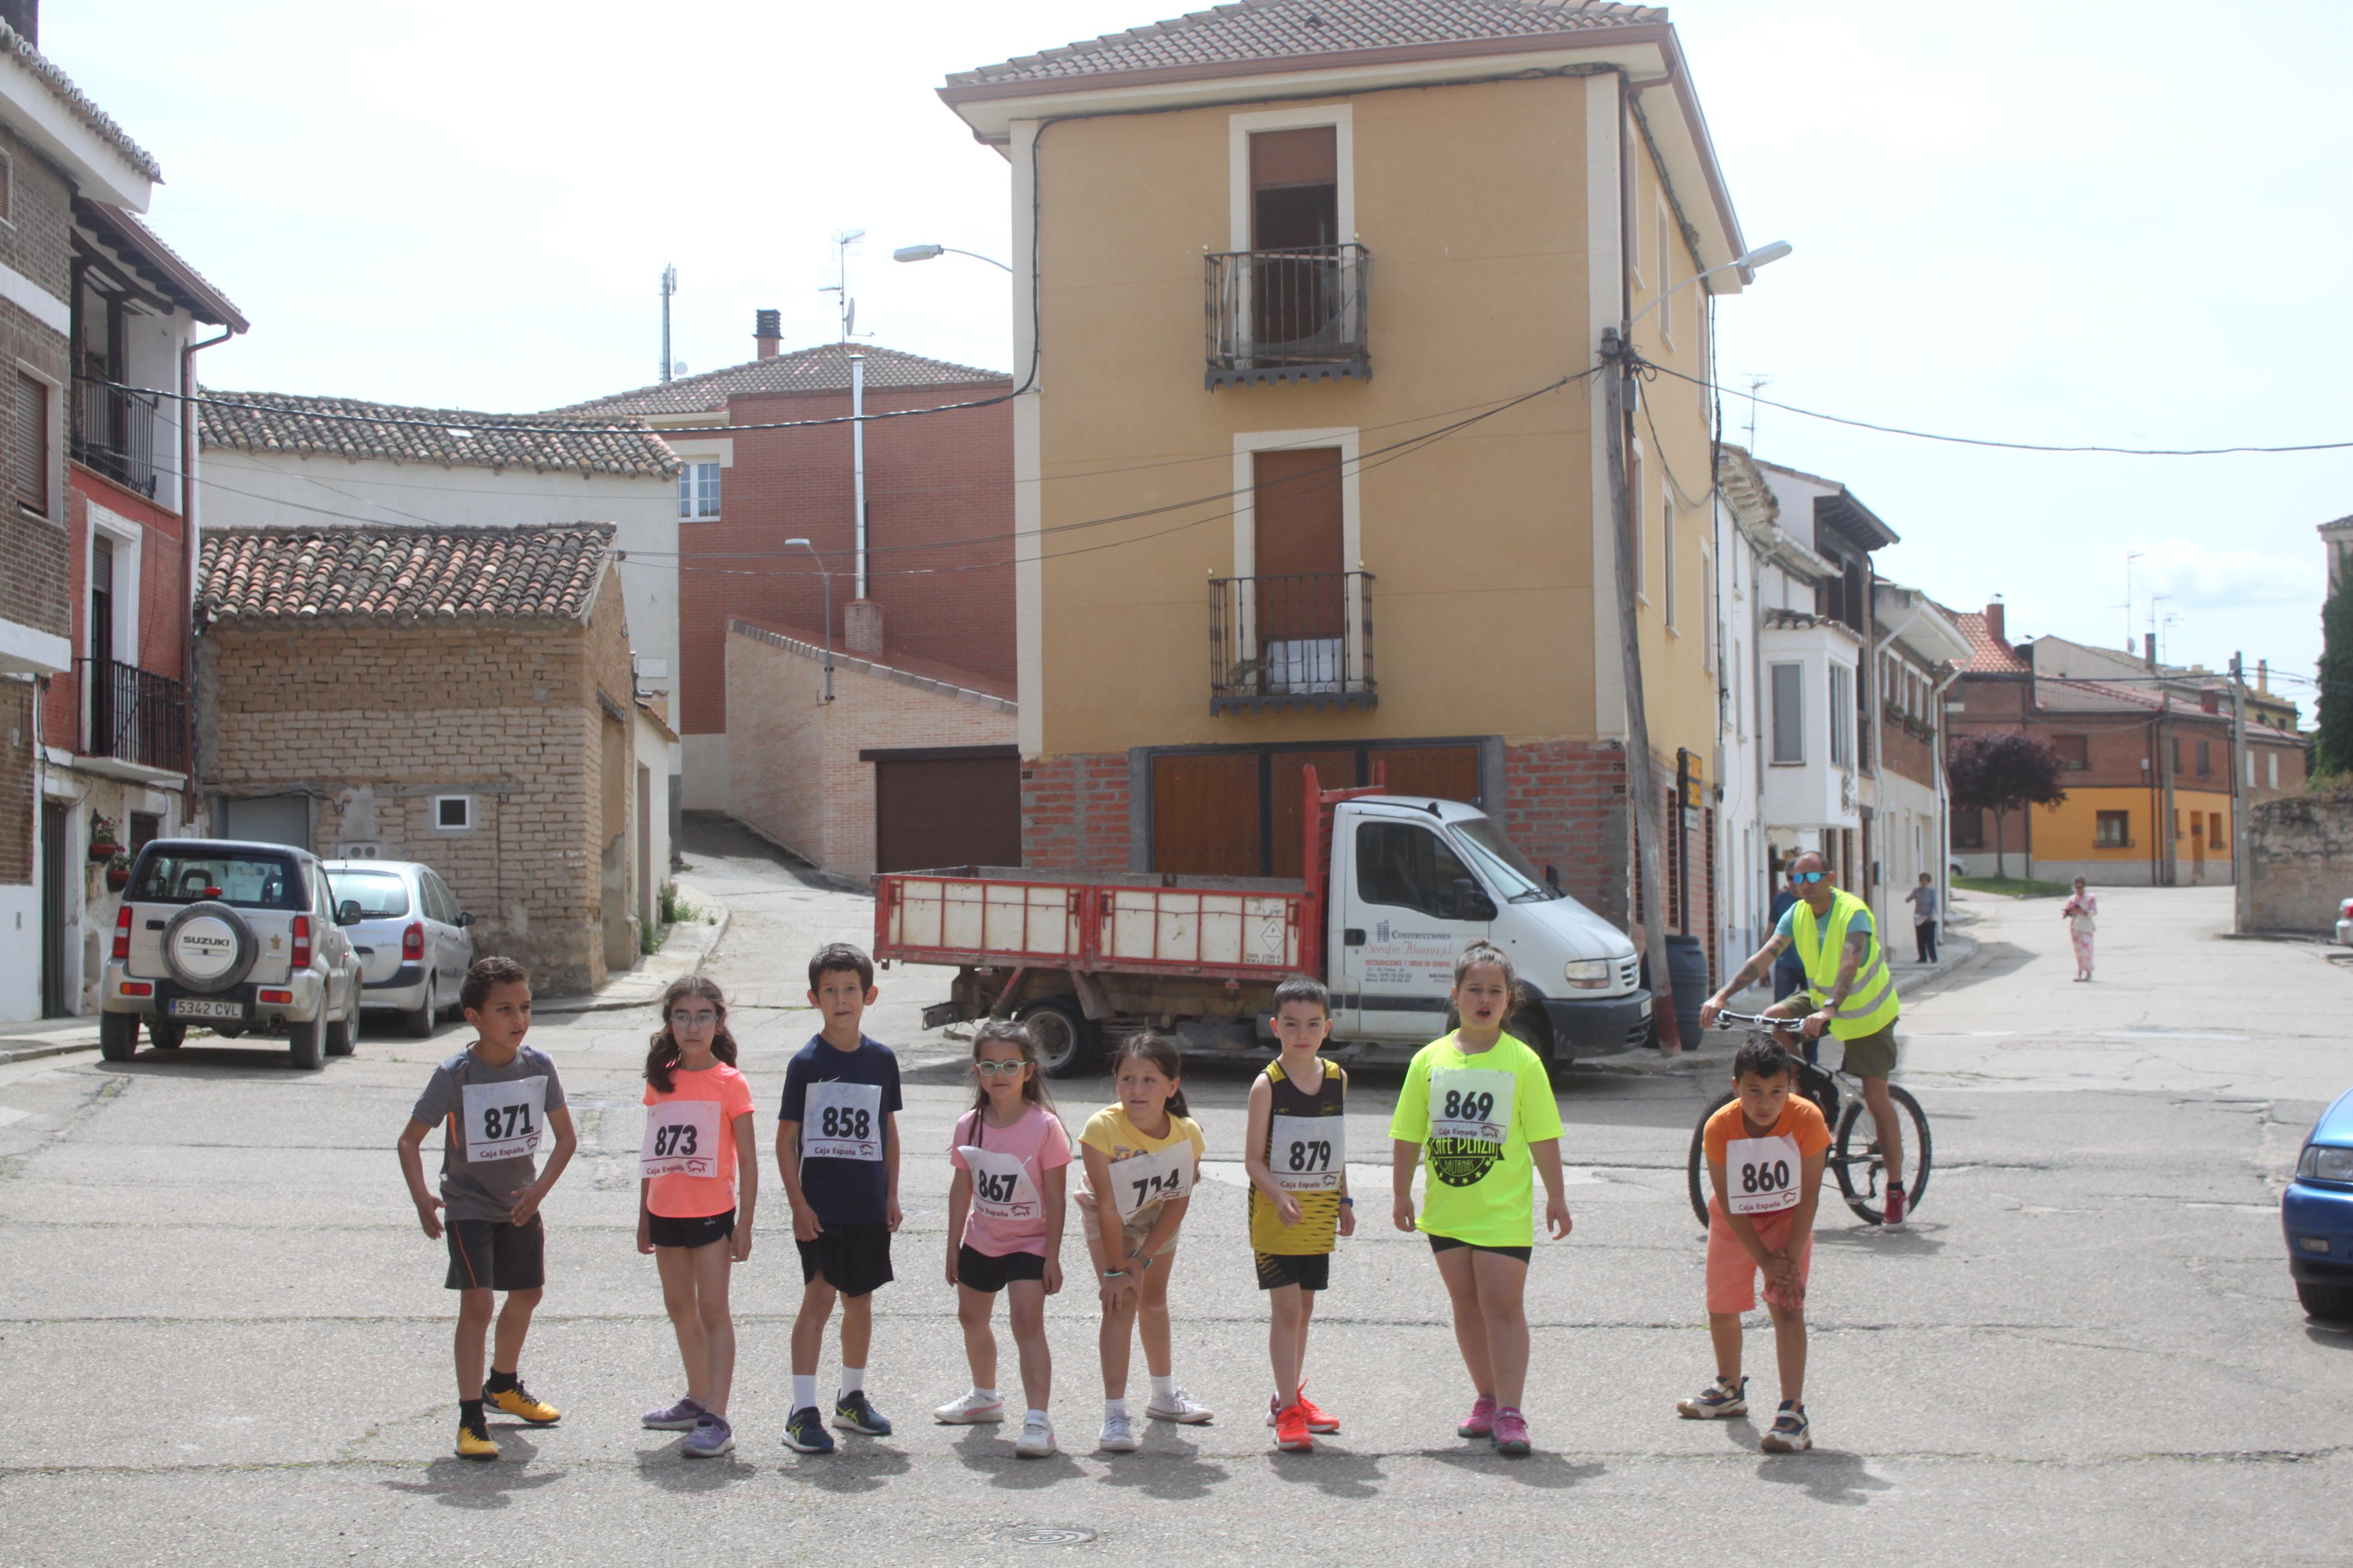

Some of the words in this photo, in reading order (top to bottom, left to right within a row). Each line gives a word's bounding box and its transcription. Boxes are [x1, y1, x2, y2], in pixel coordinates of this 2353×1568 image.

[183, 936, 229, 947] SUZUKI
[178, 1001, 211, 1015] 5342
[215, 1004, 239, 1016] CVL
[1445, 1090, 1493, 1121] 869
[484, 1103, 534, 1139] 871
[822, 1107, 870, 1140] 858
[1439, 1128, 1450, 1136] Caja
[655, 1125, 697, 1156] 873
[480, 1150, 497, 1159] Caja
[499, 1147, 524, 1156] España
[815, 1147, 831, 1155] Caja
[1289, 1140, 1331, 1172] 879
[647, 1167, 660, 1176] Caja
[1742, 1160, 1789, 1193] 860
[979, 1169, 1018, 1203] 867
[1280, 1181, 1296, 1189] Caja
[1298, 1181, 1320, 1189] España
[985, 1208, 1009, 1217] España
[1739, 1204, 1754, 1212] Caja
[1756, 1201, 1781, 1210] España
